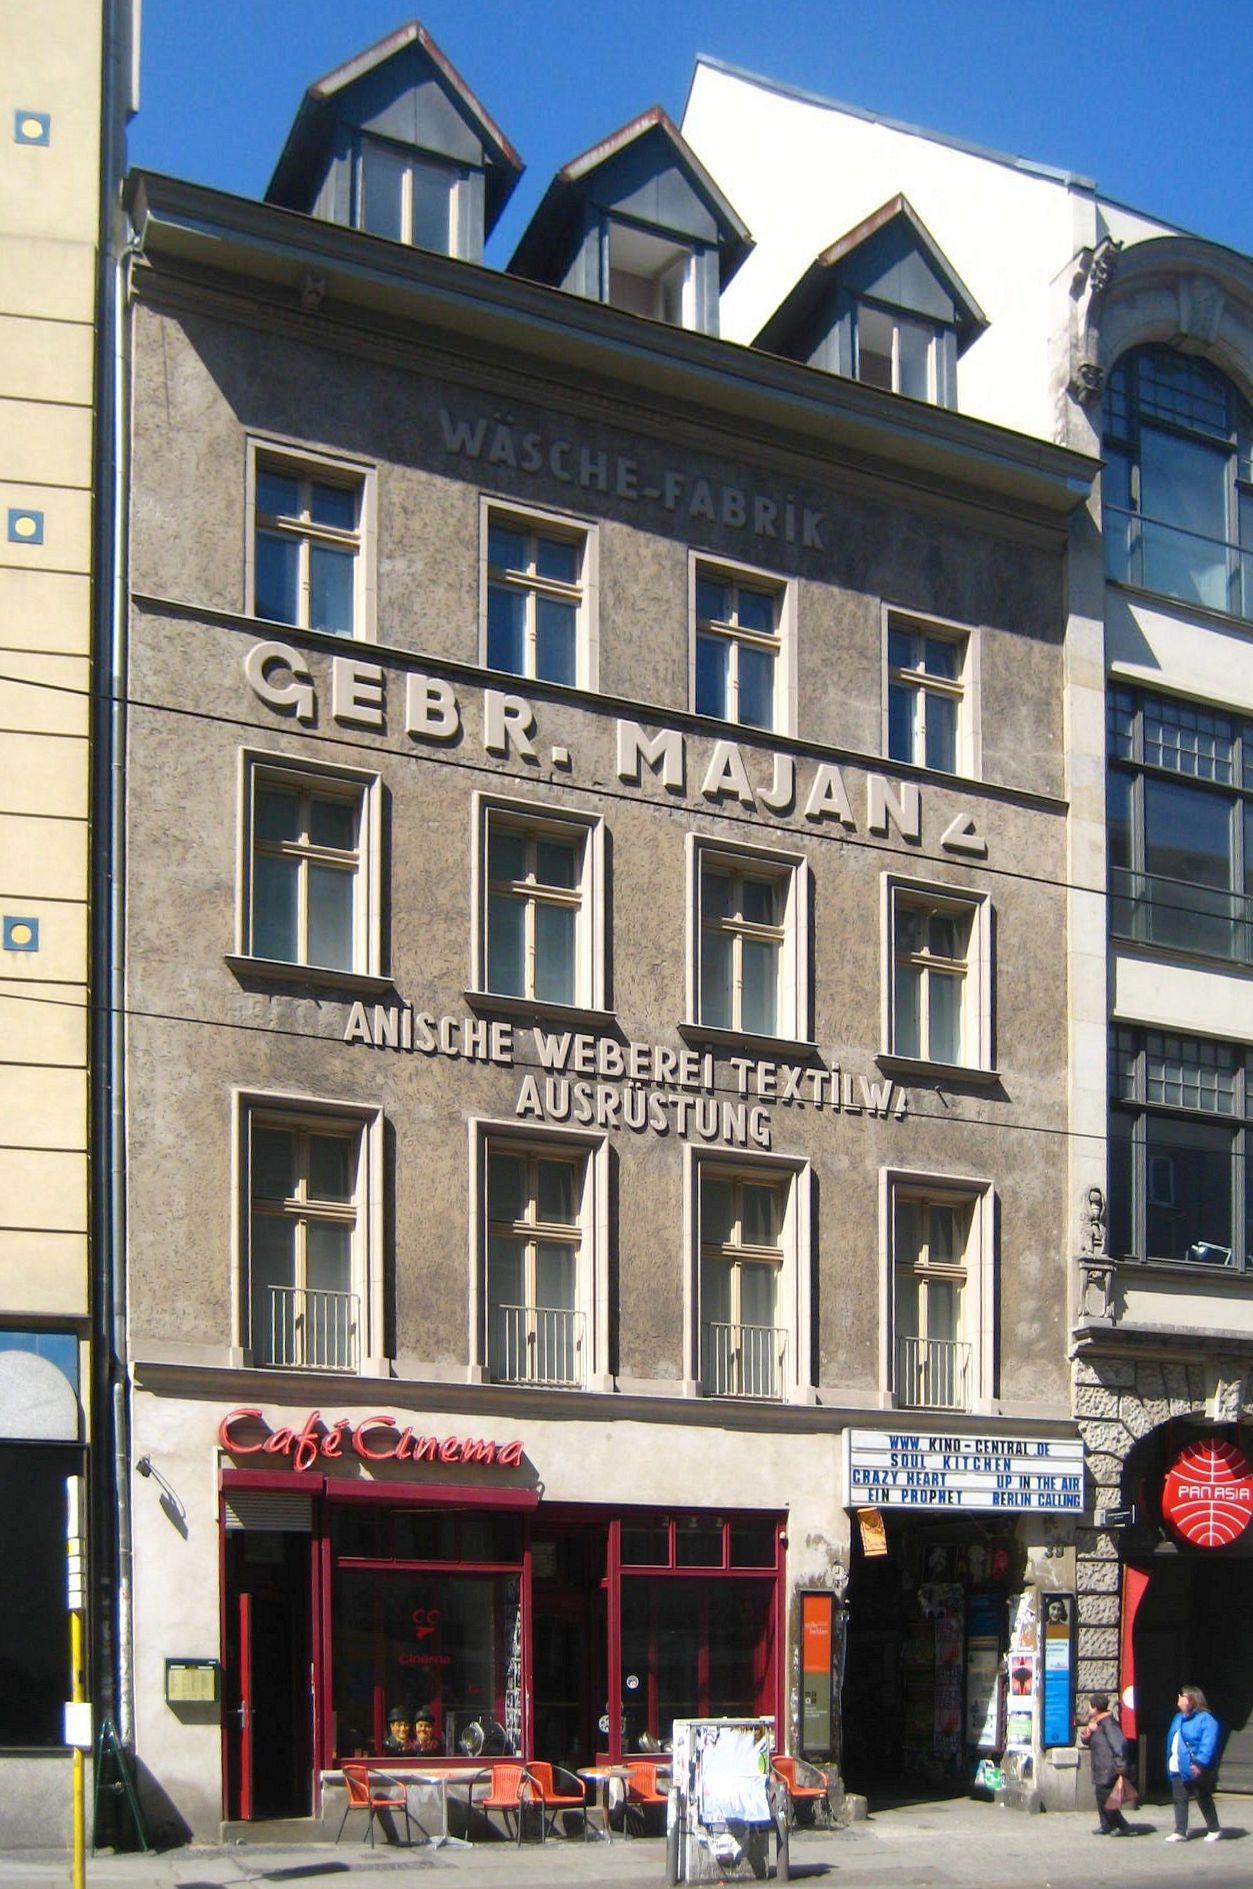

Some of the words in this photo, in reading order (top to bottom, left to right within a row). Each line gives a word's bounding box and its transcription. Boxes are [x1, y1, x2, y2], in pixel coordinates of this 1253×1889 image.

[245, 640, 571, 765] GEBR.
[343, 1000, 514, 1062] ANISCHE
[534, 1027, 714, 1090] WEBEREI
[515, 1074, 772, 1148] AUSRÜSTUNG
[218, 1407, 349, 1471] Café
[352, 1415, 524, 1468] Cinema
[890, 1453, 927, 1469] SOUL
[943, 1455, 1012, 1472] KITCHEN
[853, 1469, 898, 1486] CRAZY
[907, 1471, 947, 1487] HEART
[997, 1475, 1012, 1489] UP
[1019, 1475, 1031, 1490] IN
[1037, 1476, 1057, 1491] THE
[1061, 1477, 1080, 1491] AIR
[868, 1488, 890, 1502] EIN
[901, 1489, 963, 1505] PROPHET
[993, 1491, 1032, 1507] BERLIN
[1038, 1493, 1081, 1508] CALLING
[1178, 1485, 1211, 1498] PAN
[1214, 1487, 1250, 1501] ASIA
